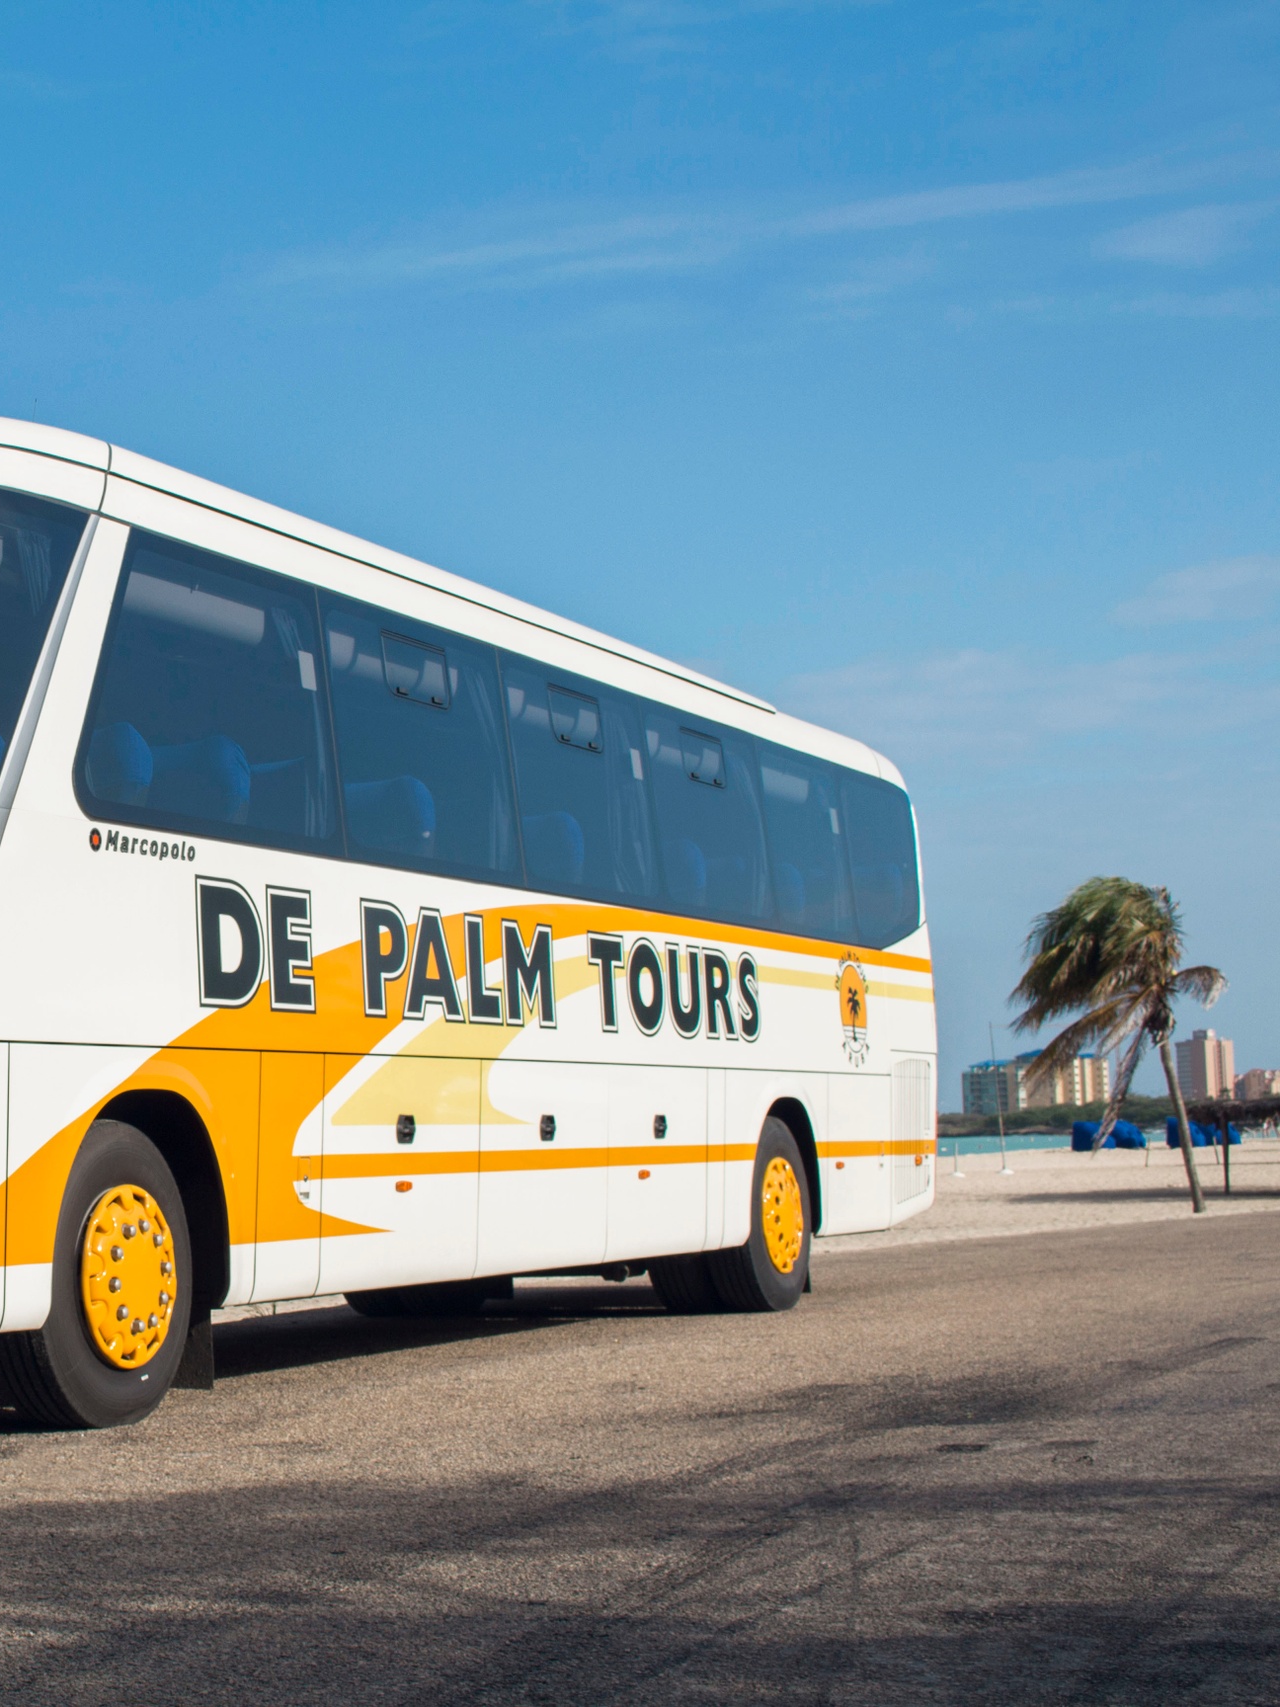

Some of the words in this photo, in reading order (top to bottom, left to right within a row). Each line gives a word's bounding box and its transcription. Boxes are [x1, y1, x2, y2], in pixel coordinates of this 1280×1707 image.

[104, 833, 196, 863] Marcopolo
[195, 874, 316, 1014] DE
[359, 897, 557, 1030] PALM
[586, 930, 762, 1044] TOURS
